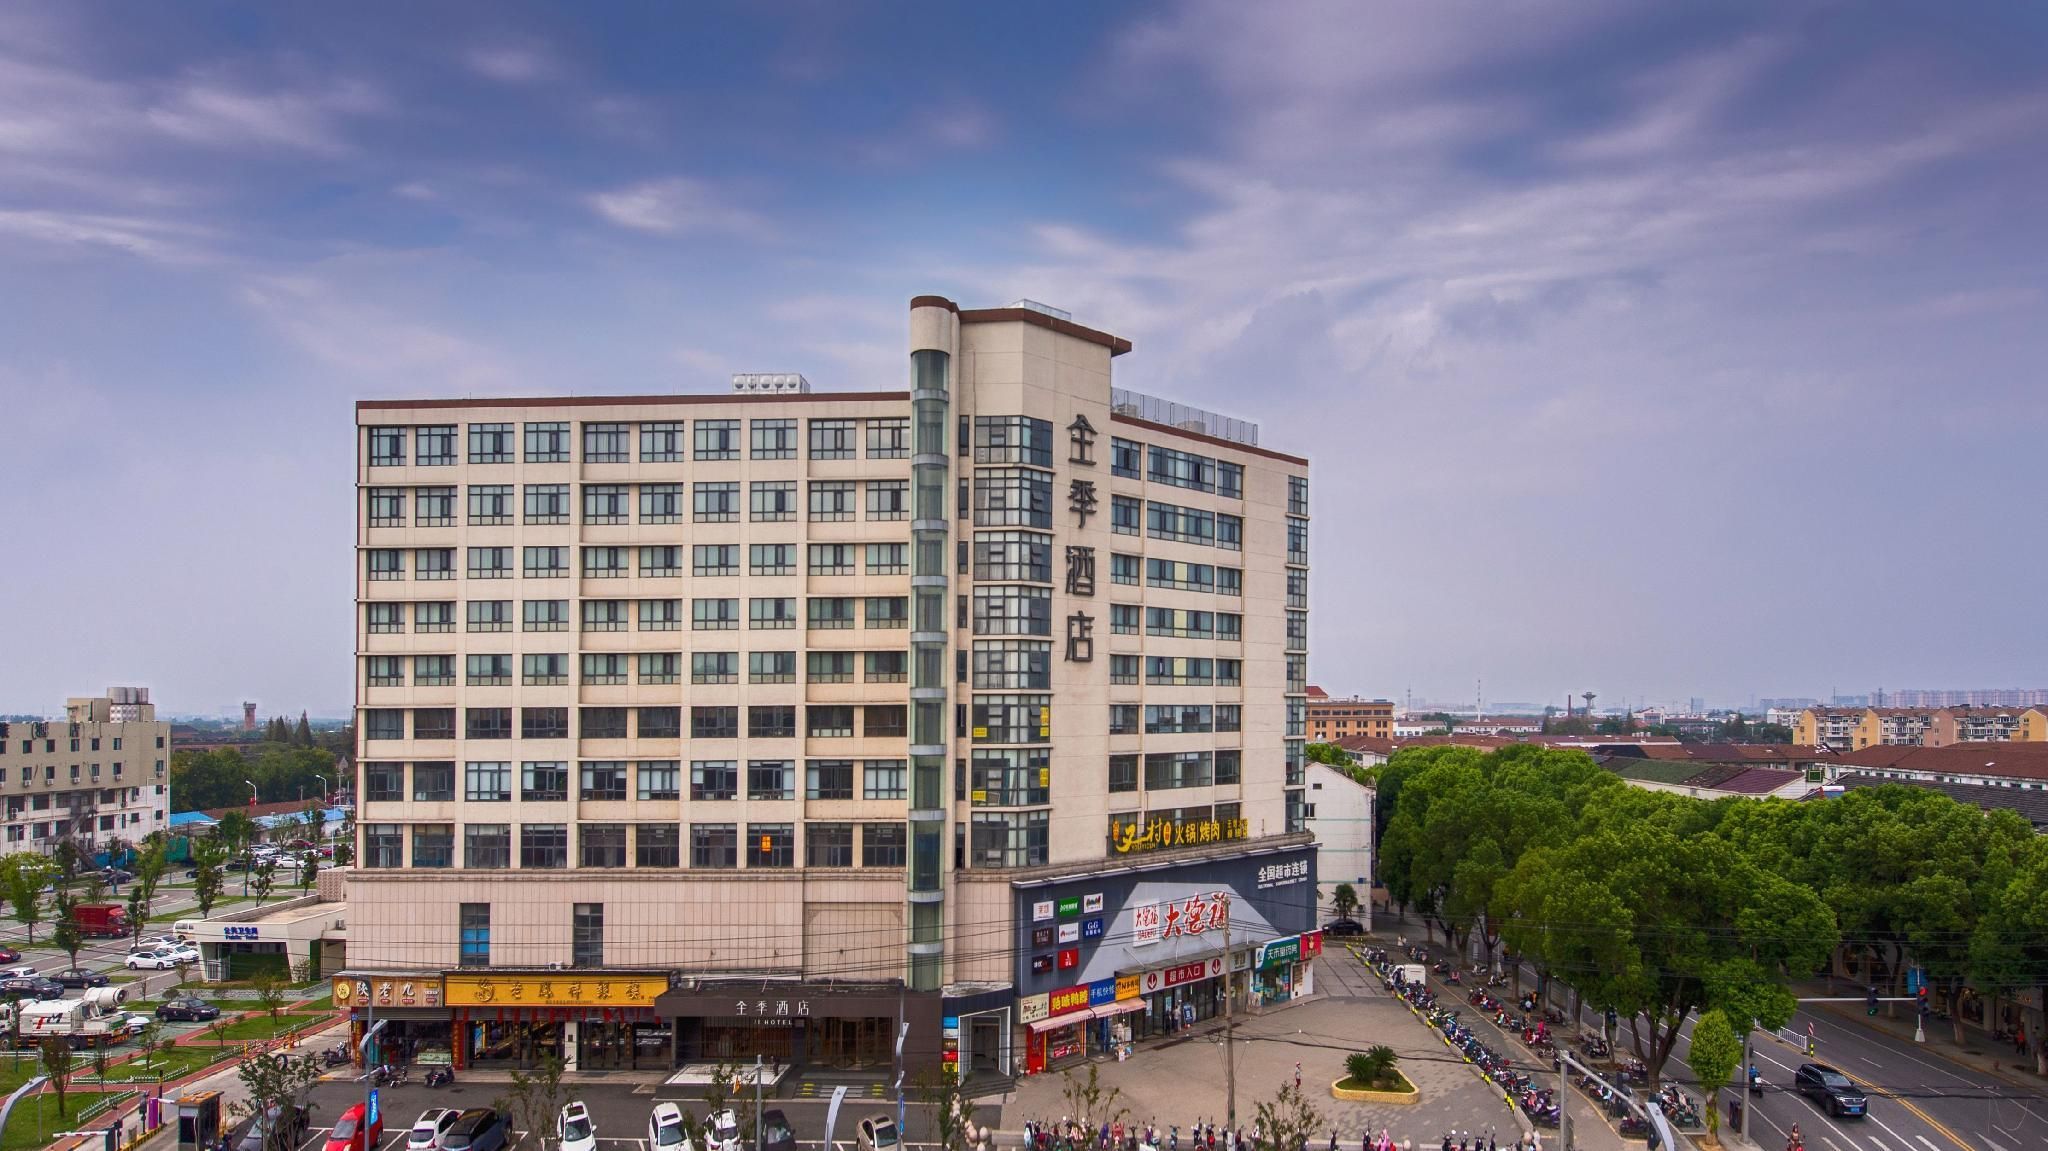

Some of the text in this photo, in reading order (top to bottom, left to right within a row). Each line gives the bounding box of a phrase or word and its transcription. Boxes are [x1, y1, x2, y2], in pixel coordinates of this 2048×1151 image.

[1065, 413, 1098, 662] 全季酒店
[1174, 823, 1197, 845] 火锅
[1199, 819, 1220, 842] 烤肉
[1258, 860, 1308, 882] 全国超市连锁
[1169, 966, 1200, 982] 超市入口
[736, 1000, 810, 1016] 全季酒店
